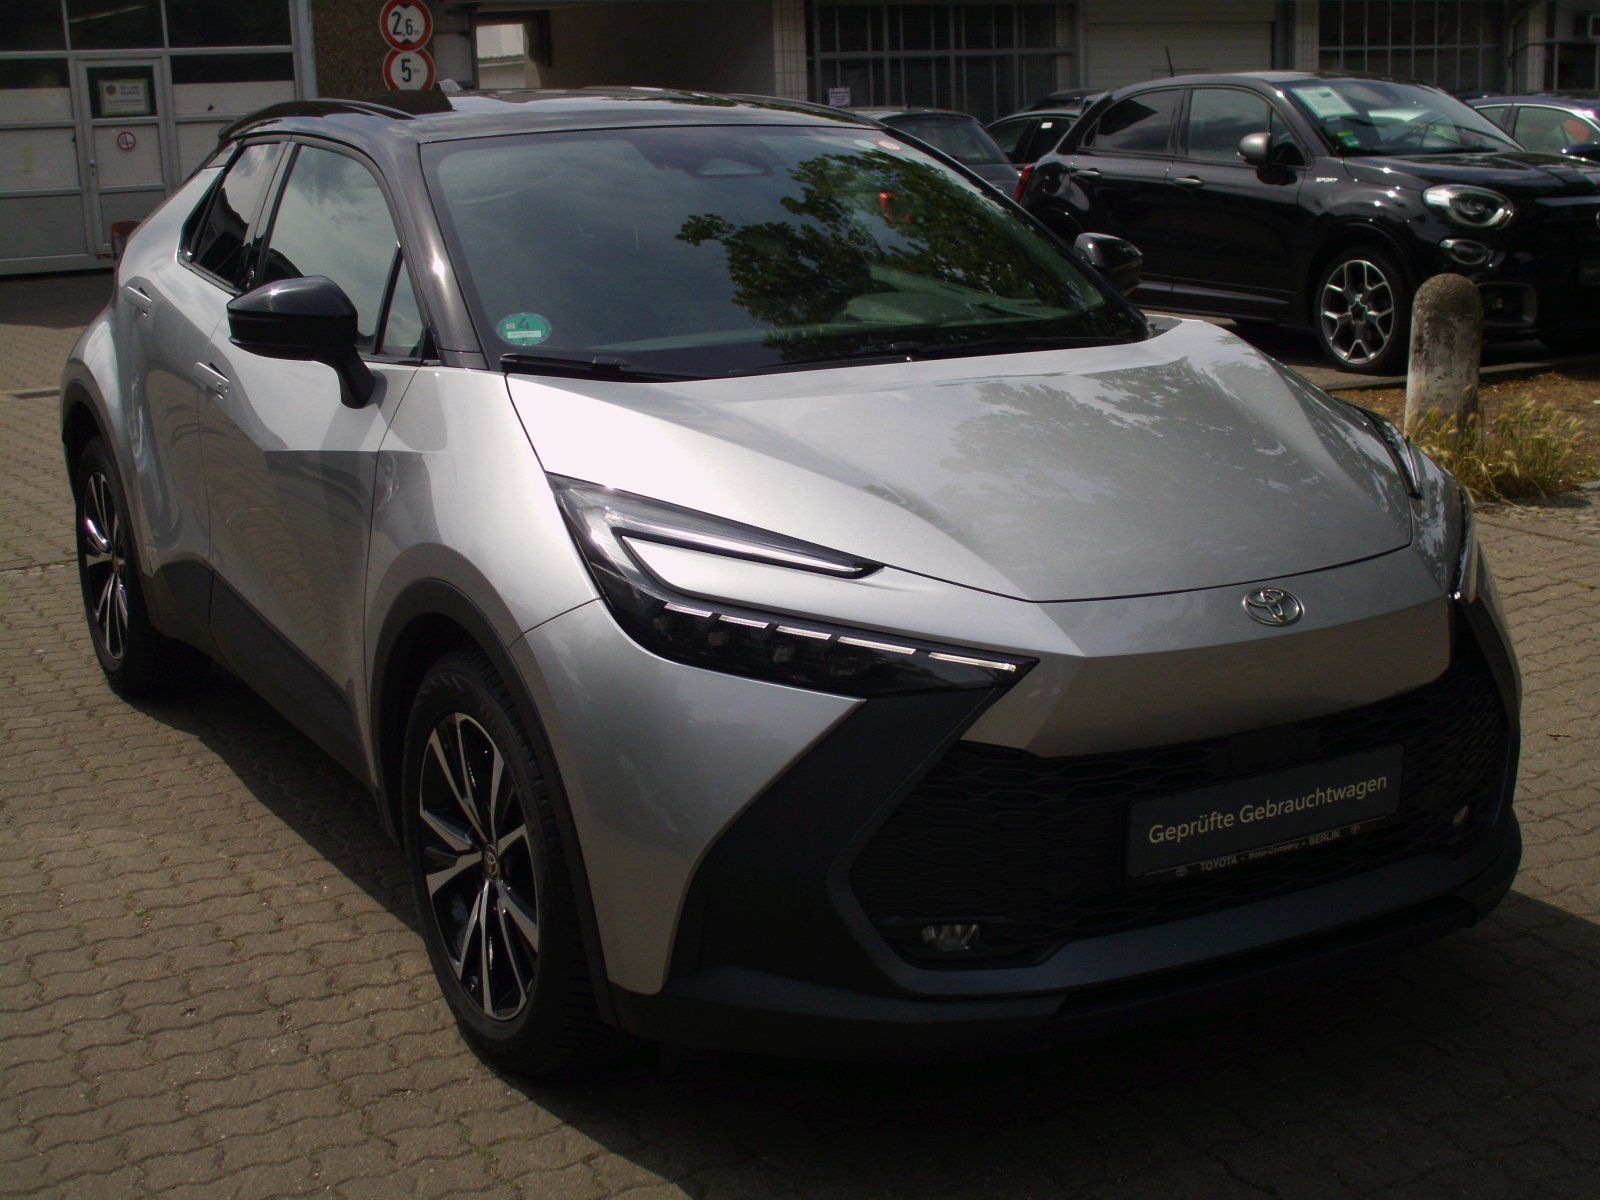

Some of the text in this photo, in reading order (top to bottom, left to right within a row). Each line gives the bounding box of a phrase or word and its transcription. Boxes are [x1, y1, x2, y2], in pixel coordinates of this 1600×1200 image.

[401, 58, 412, 83] 5
[518, 316, 529, 329] 4
[1148, 775, 1388, 844] Geprüfte Gebrauchtwagen
[1199, 855, 1238, 873] TOYOTA
[1308, 829, 1341, 846] BERLIN
